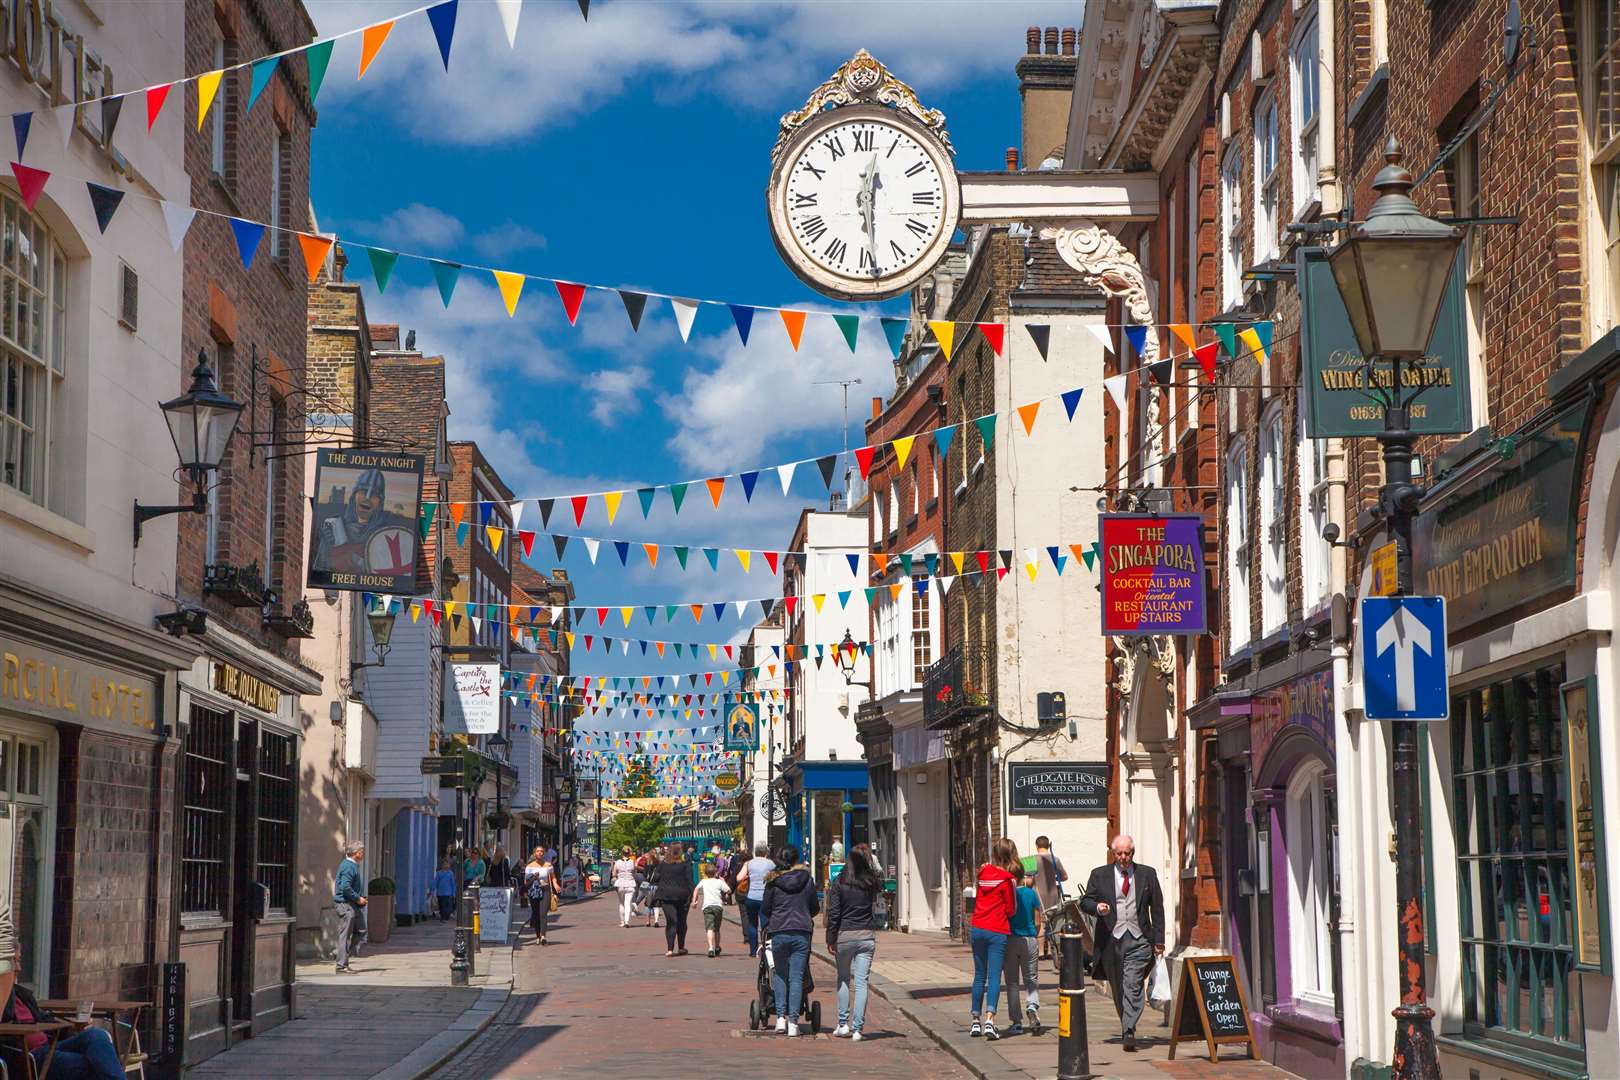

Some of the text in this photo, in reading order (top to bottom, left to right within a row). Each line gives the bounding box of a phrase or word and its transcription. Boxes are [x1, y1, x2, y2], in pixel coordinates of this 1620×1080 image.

[852, 131, 874, 152] XII
[824, 136, 846, 162] XI
[803, 162, 826, 180] X
[904, 162, 926, 177] II
[912, 192, 934, 205] III
[328, 453, 416, 469] THE JOLLY KNIGHT
[1137, 527, 1165, 541] THE
[1108, 544, 1197, 575] SINGAPORA
[1427, 559, 1461, 600] WINE
[1464, 517, 1542, 595] EMPORIUM
[331, 573, 394, 587] FREE HOUSE
[1113, 578, 1191, 589] COCKTAIL BAR
[1134, 592, 1176, 601] Oriental
[1115, 600, 1194, 612] RESTAURANT
[1124, 612, 1182, 623] UPSTAIRS
[454, 666, 487, 678] Capture
[225, 663, 280, 714] THE JOLLY KNIGHT
[453, 681, 480, 692] Castle
[90, 676, 155, 730] HOTEL
[1076, 773, 1107, 788] HOUSE
[1198, 968, 1231, 984] Lounge
[1207, 981, 1227, 993] Bar
[1206, 1000, 1241, 1012] Garden
[1216, 1012, 1239, 1024] Open
